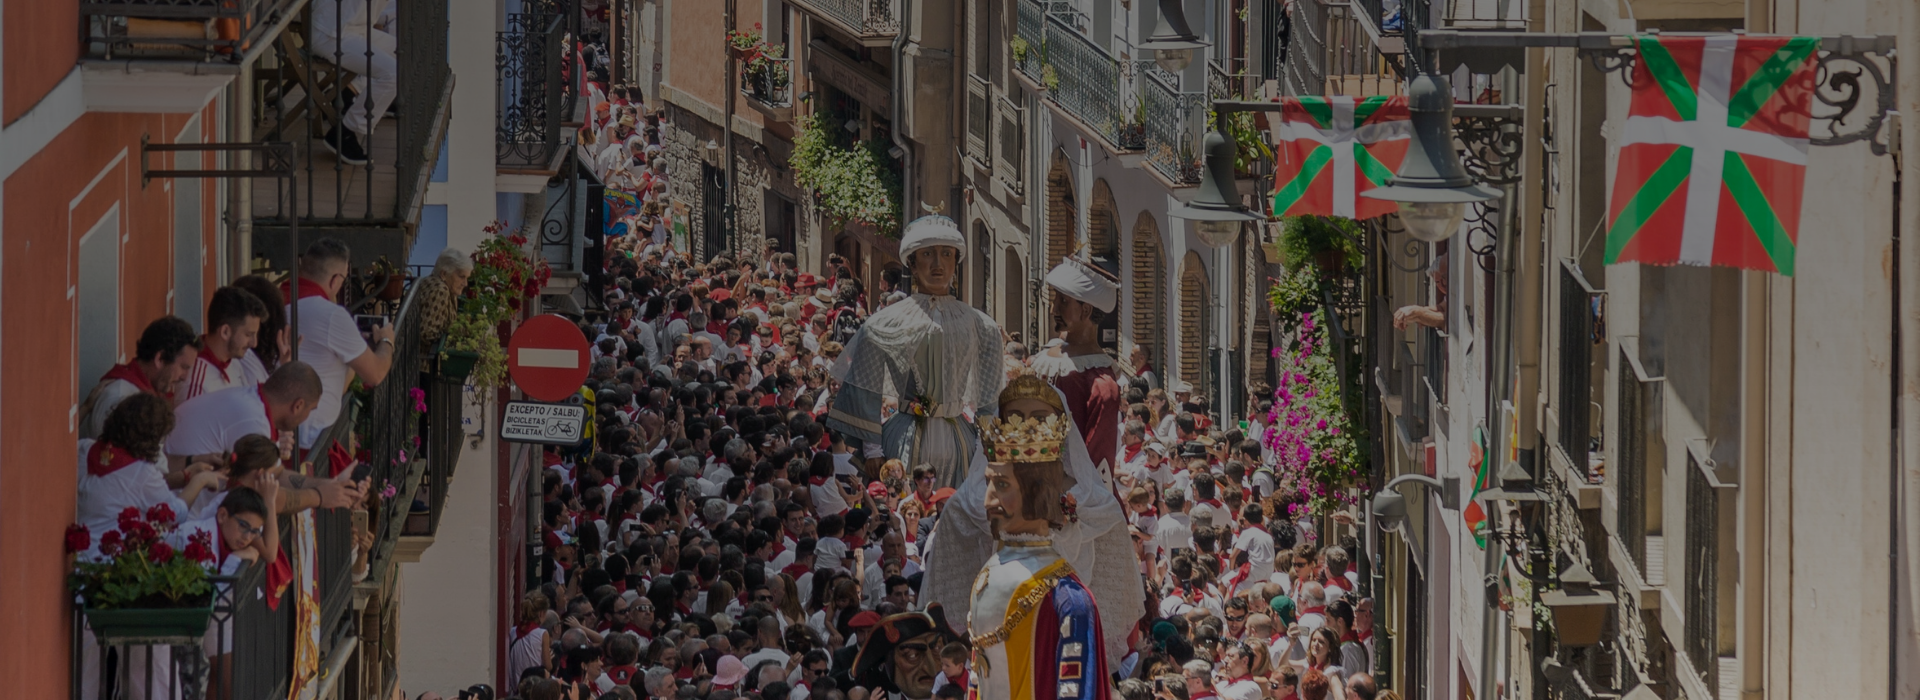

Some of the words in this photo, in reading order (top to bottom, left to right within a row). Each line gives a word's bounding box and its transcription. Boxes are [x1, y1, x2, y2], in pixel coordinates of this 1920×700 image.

[510, 405, 545, 415] EXCEPTO
[552, 407, 580, 418] SALBU:
[507, 416, 546, 425] BICICLETAS
[505, 427, 543, 436] BIZIKLETAK
